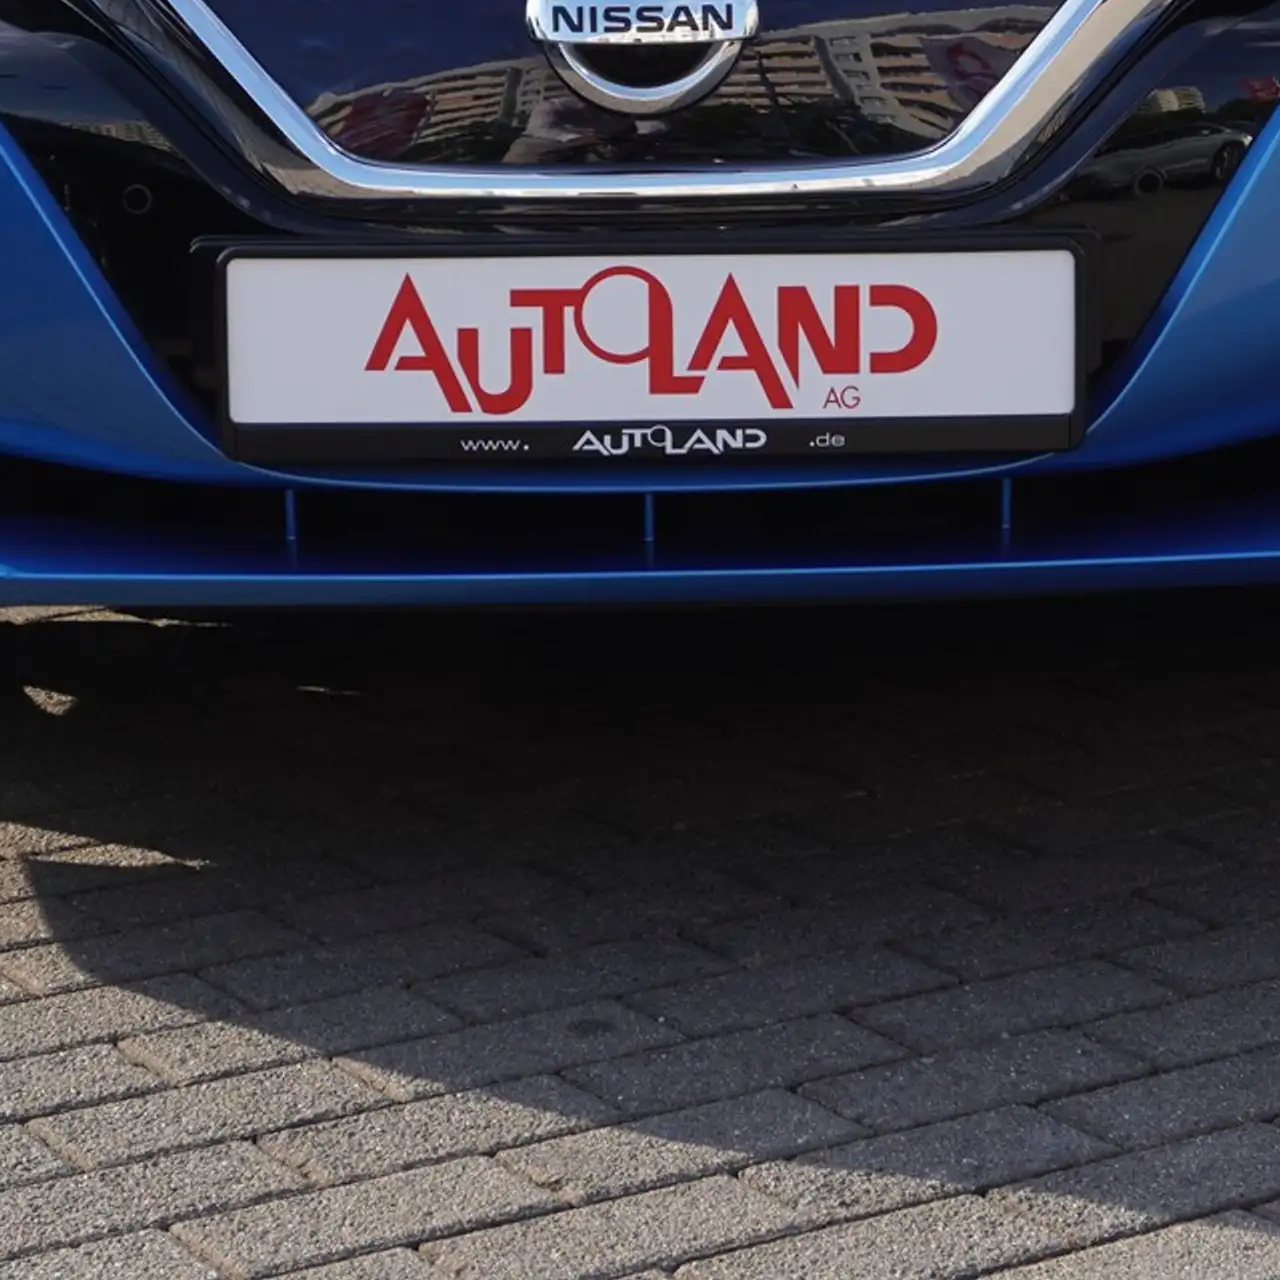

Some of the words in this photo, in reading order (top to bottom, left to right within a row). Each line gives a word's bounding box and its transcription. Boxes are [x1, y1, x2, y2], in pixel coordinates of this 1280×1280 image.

[551, 3, 733, 34] NISSAN
[364, 264, 938, 415] AUTOLAND
[822, 385, 862, 410] AG
[461, 439, 530, 452] www.
[572, 424, 767, 457] AUTOLAND
[808, 433, 846, 449] .de
